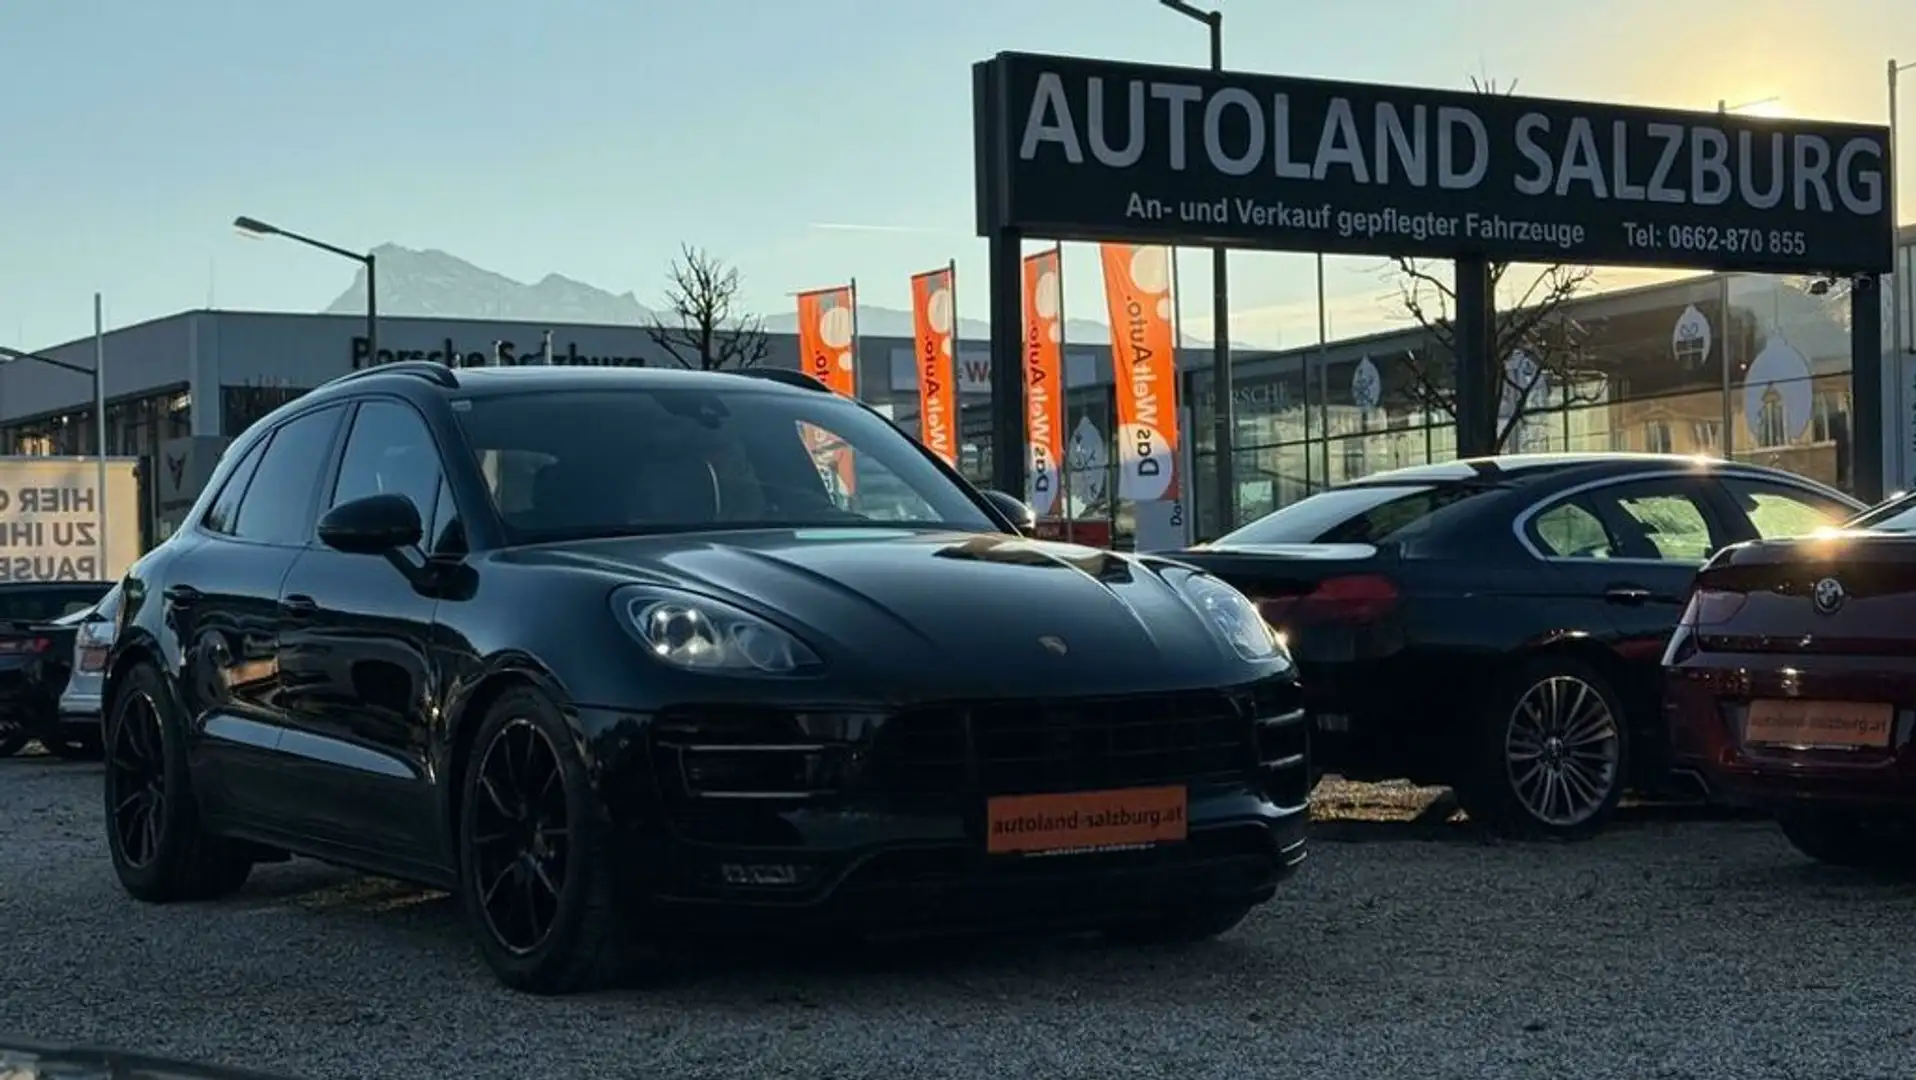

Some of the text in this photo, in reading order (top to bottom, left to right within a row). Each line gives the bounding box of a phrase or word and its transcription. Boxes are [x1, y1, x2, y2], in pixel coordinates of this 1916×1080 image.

[1019, 72, 1883, 215] AUTOLAND SALZBURG
[1125, 192, 1585, 249] An- und Verkauf gepflegter Fahrzeuge
[1621, 221, 1806, 255] Tel: 0662-870 855
[993, 805, 1184, 835] autoland-salzburg.at
